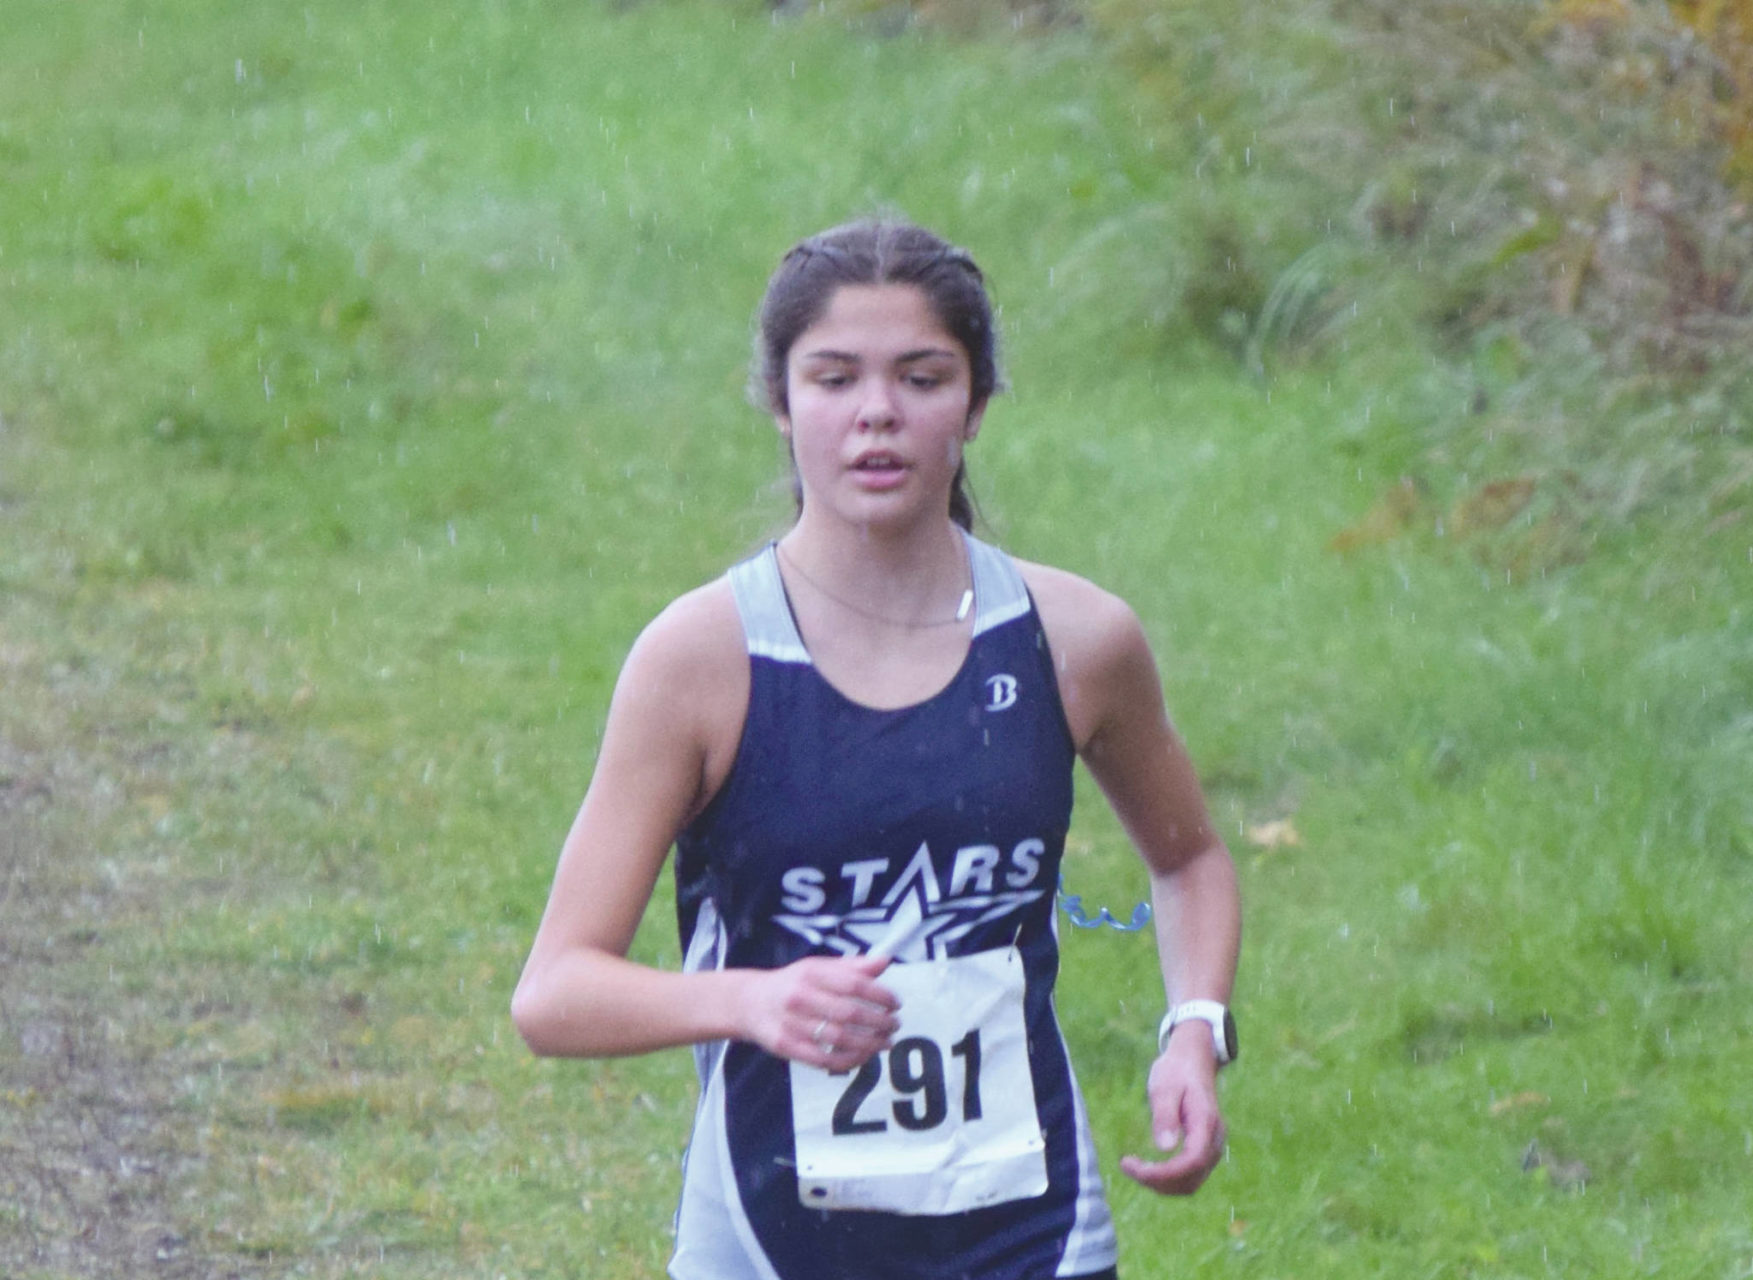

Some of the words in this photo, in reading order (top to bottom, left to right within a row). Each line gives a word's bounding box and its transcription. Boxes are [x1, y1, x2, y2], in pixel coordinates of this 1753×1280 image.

[985, 673, 1017, 712] B
[781, 838, 1046, 914] STARS
[828, 1028, 983, 1136] 291
